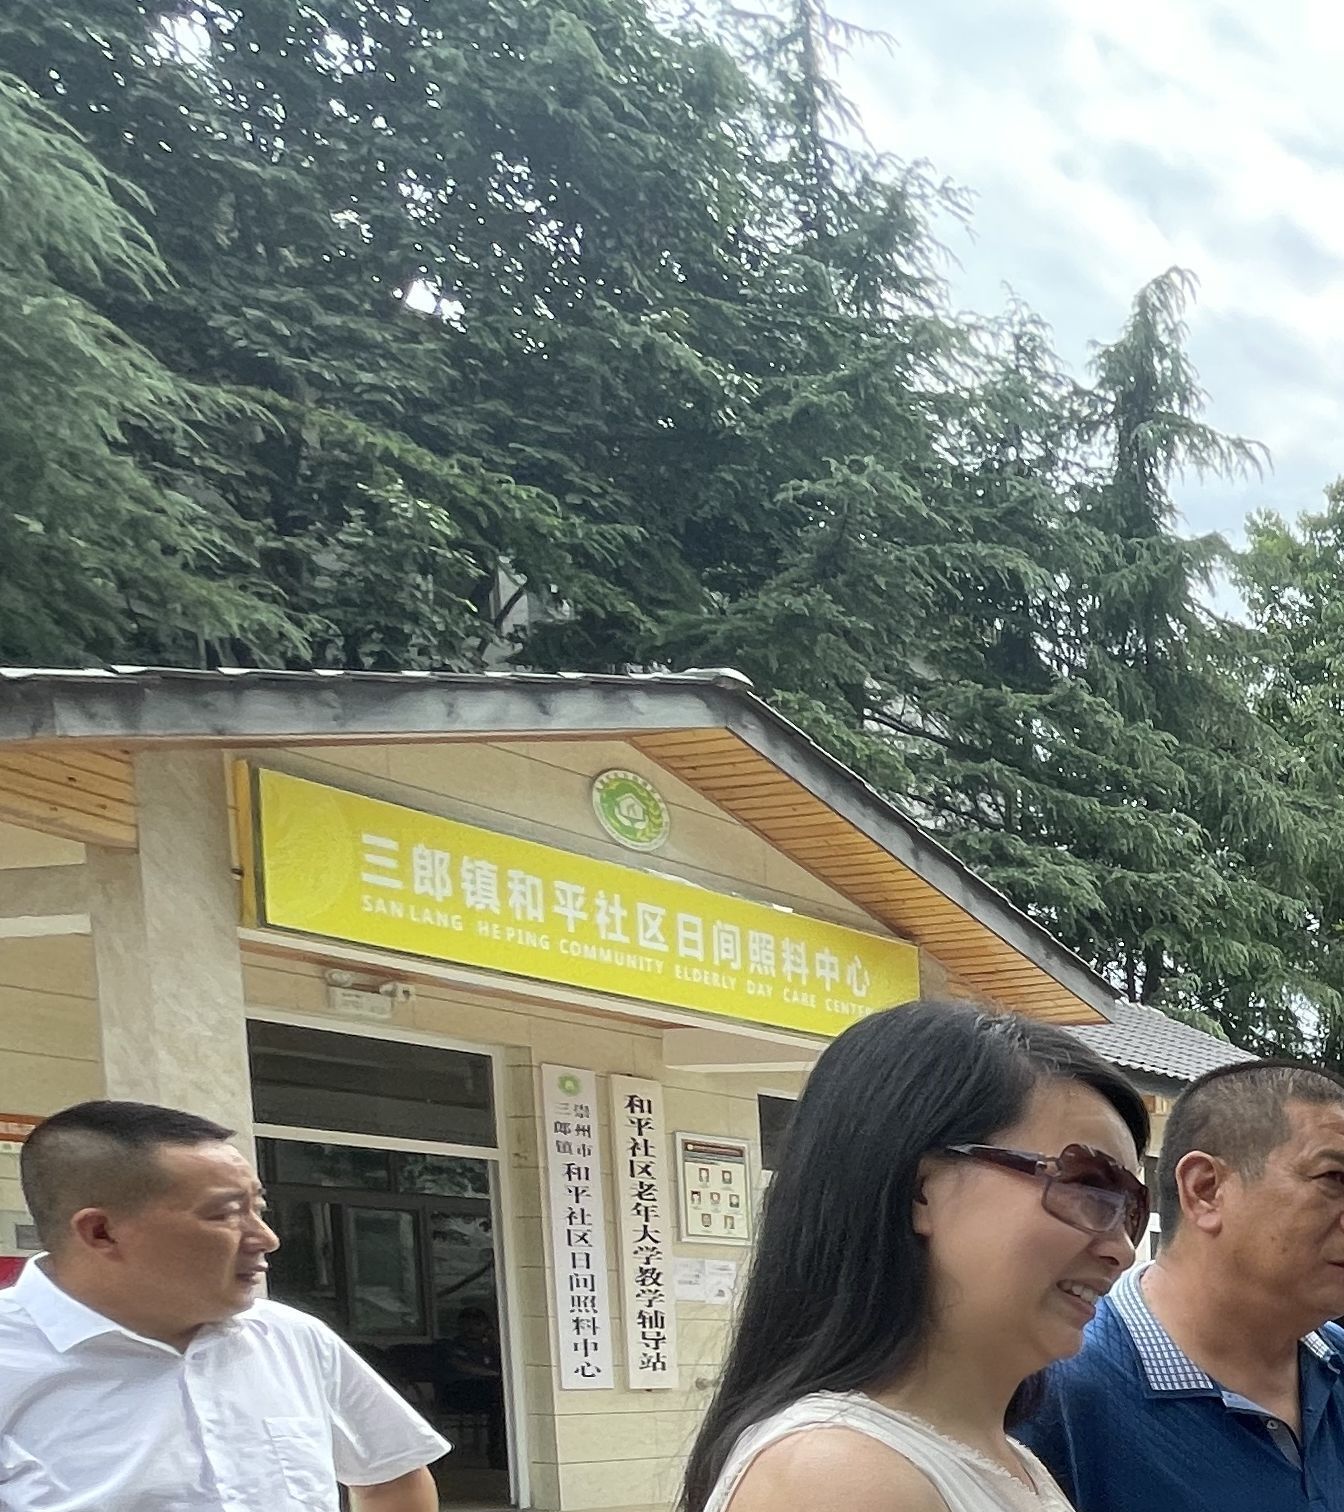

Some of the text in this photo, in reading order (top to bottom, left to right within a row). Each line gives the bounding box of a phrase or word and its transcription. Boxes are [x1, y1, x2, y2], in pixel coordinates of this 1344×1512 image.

[361, 832, 870, 998] 三郎镇和平社区日间照料中心
[559, 938, 664, 974] COMMUNITY
[674, 964, 737, 991] ELDERLY
[746, 979, 774, 998] DAY
[783, 988, 817, 1009] CARE
[562, 1162, 601, 1378] 和平社区日间照料中心
[624, 1094, 667, 1371] 和平社区老年大学教学辅导站
